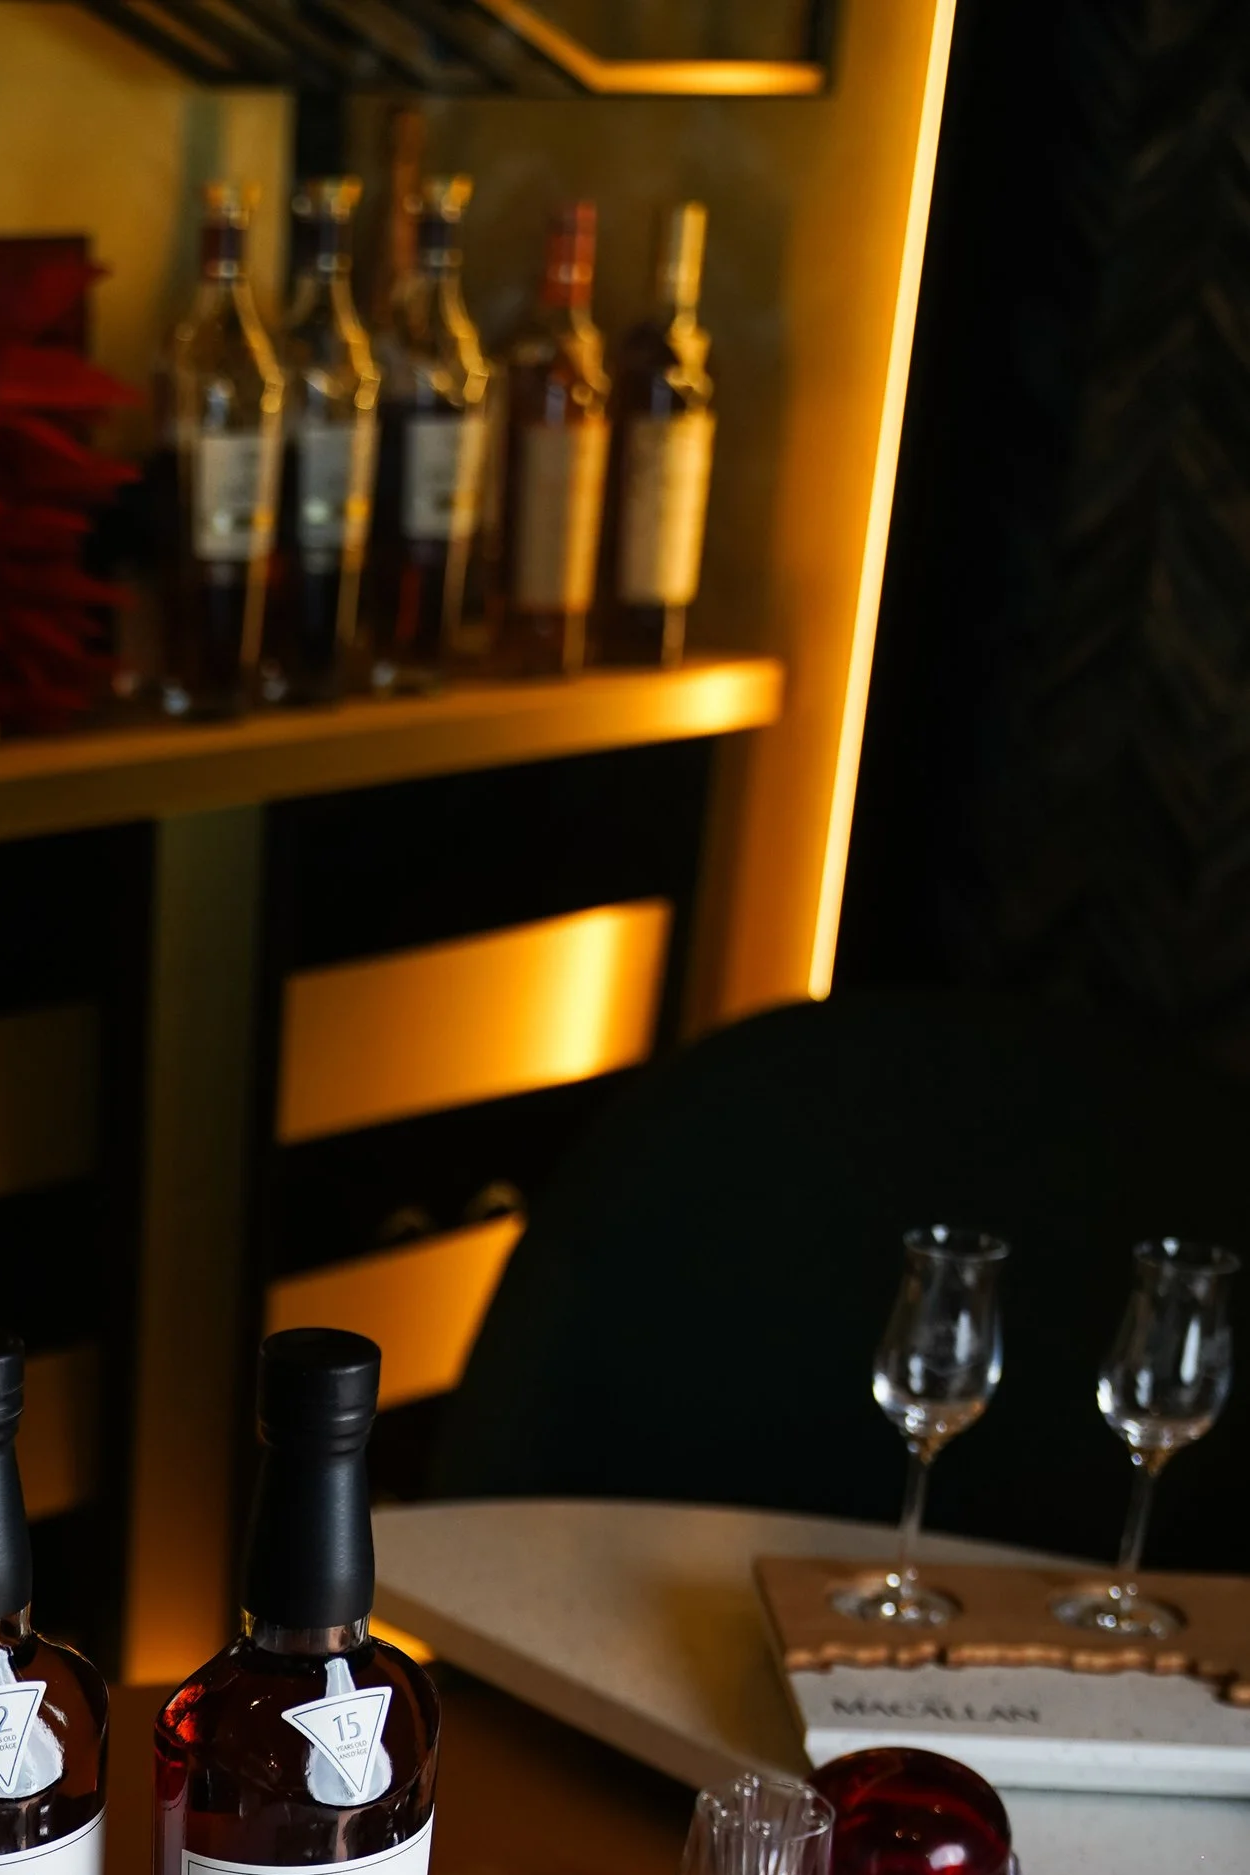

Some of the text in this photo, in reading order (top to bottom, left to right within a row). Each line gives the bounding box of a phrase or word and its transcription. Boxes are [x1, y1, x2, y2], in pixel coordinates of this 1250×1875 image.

[332, 1712, 361, 1741] 15
[3, 1734, 17, 1742] OLD
[336, 1740, 368, 1752] YEARS OLD
